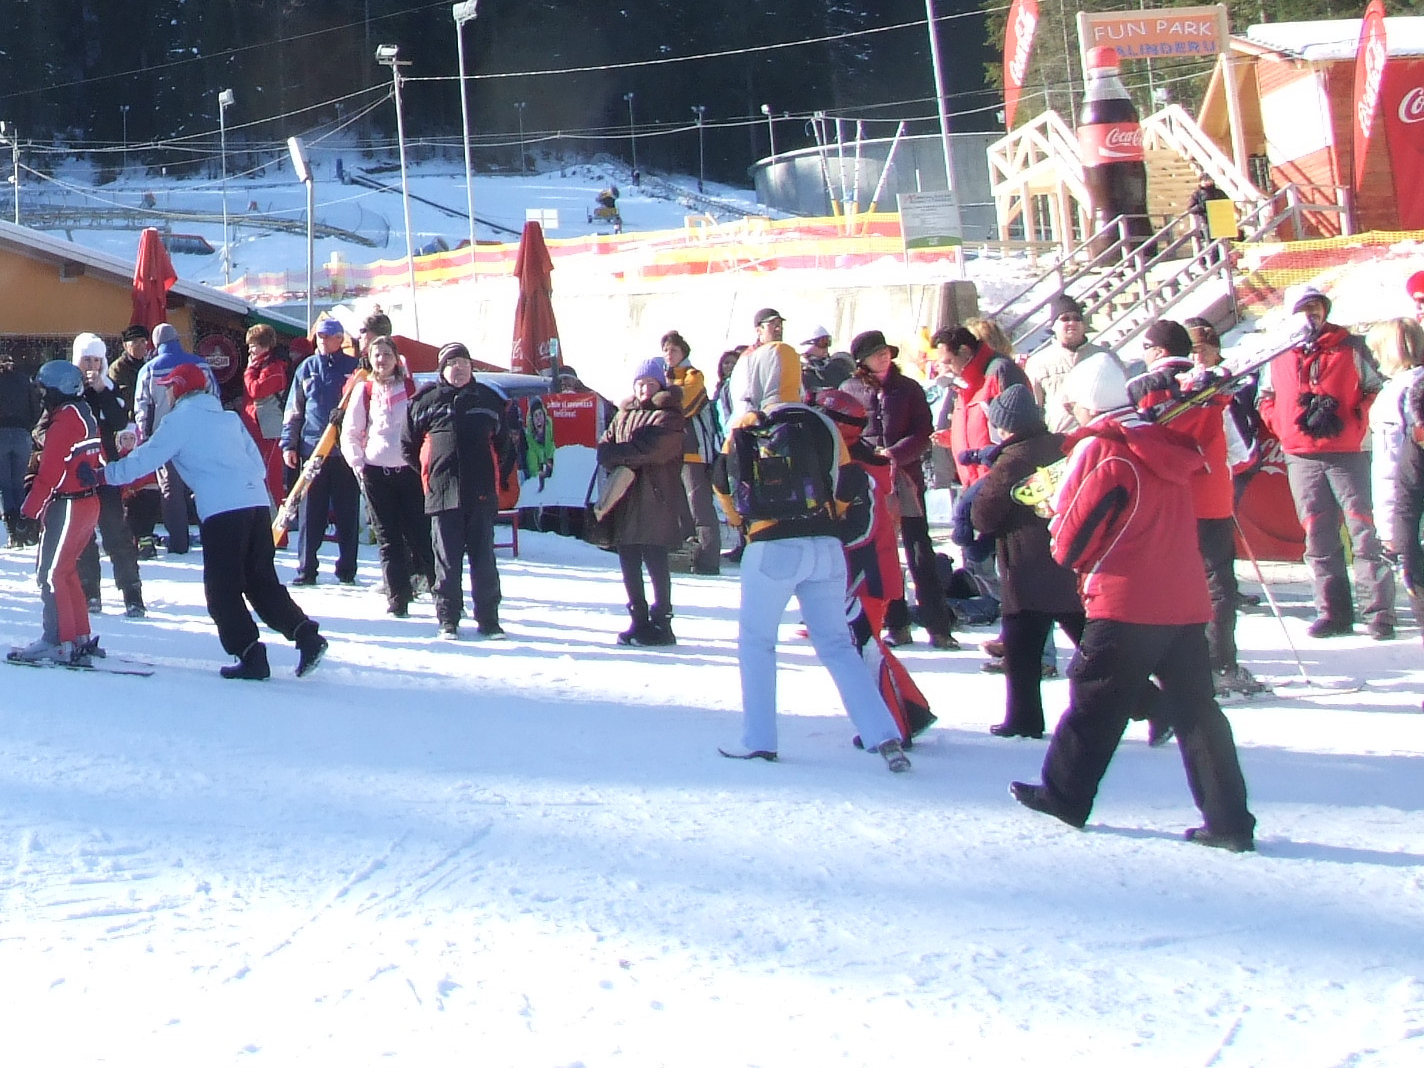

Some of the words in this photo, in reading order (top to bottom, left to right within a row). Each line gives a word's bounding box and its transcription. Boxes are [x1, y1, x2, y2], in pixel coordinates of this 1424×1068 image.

[1094, 21, 1146, 41] FUN
[1156, 19, 1212, 37] PARK
[1116, 41, 1215, 57] ALINDERU
